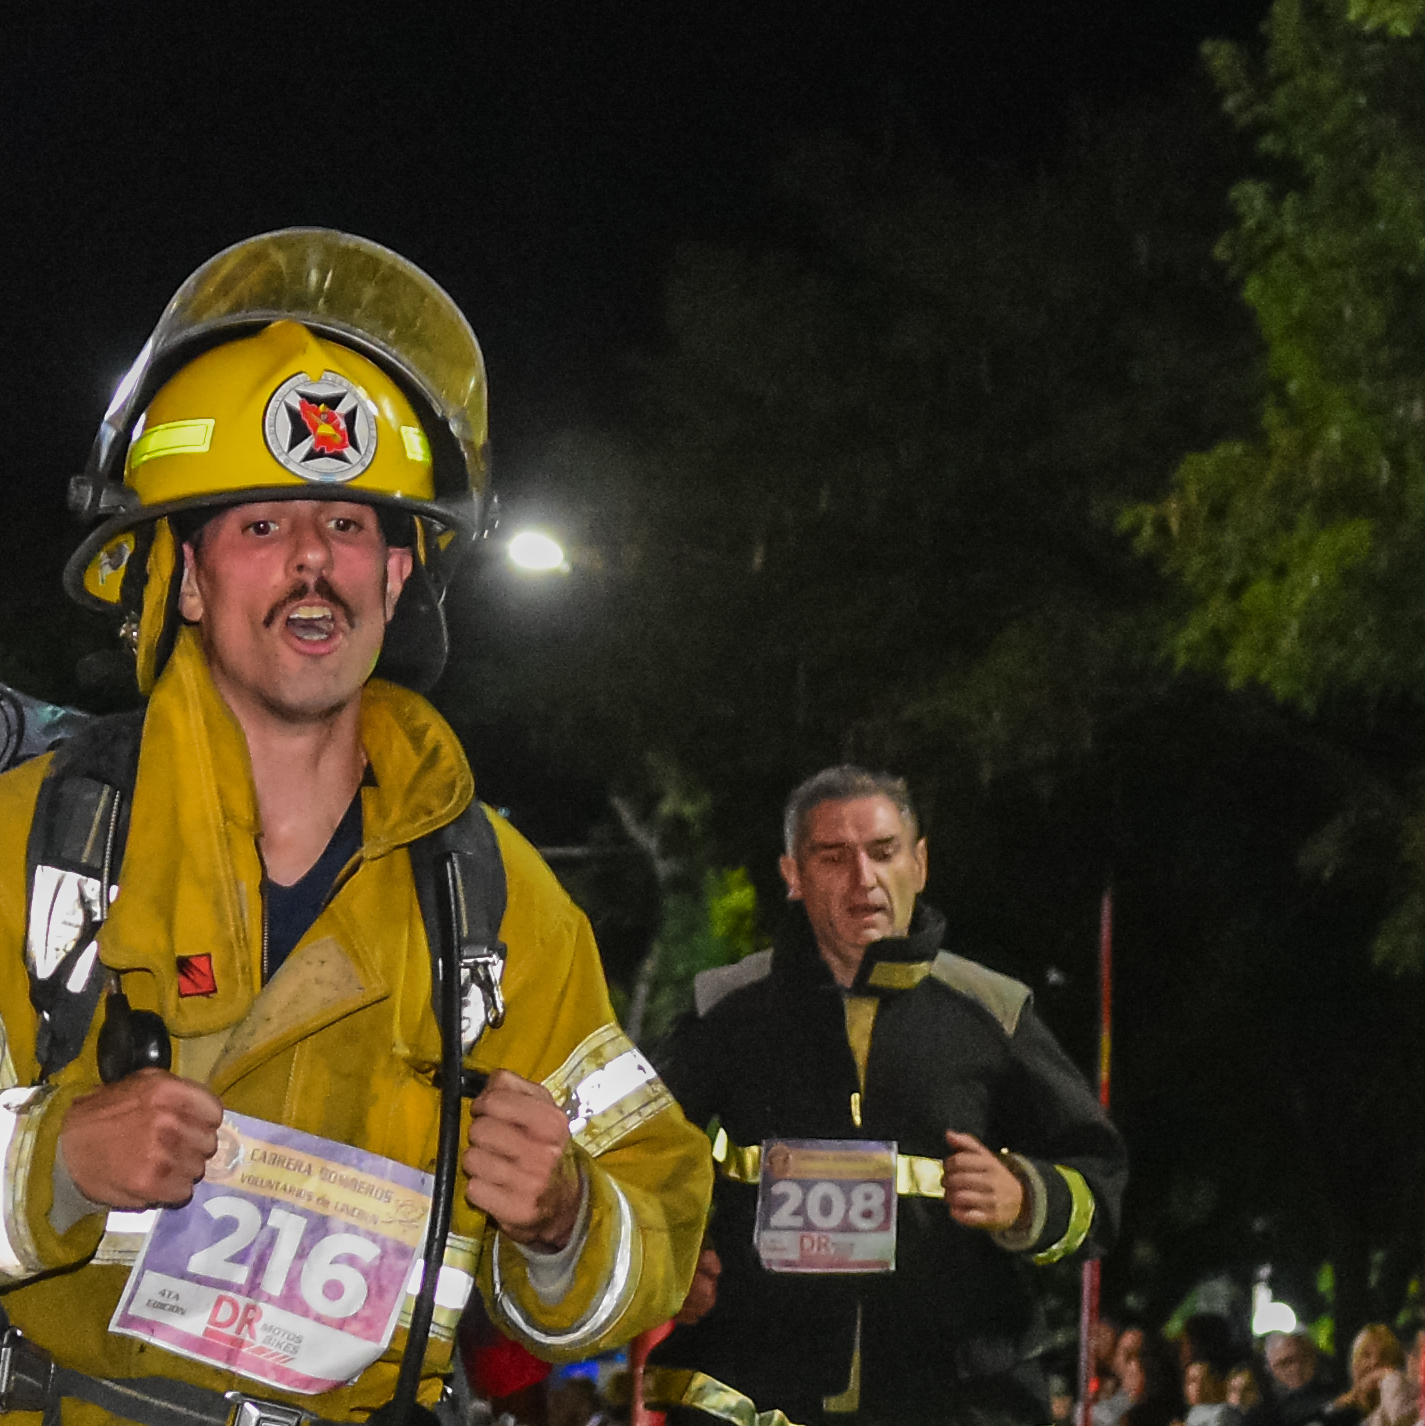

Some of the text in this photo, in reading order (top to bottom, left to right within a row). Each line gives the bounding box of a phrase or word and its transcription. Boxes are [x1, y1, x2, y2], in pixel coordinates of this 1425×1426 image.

[250, 1148, 312, 1176] CARRERA
[770, 1180, 886, 1230] 208
[187, 1195, 382, 1319] 216
[800, 1234, 832, 1253] DR
[206, 1294, 264, 1342] DR
[260, 1322, 304, 1344] MOTOS
[262, 1334, 301, 1355] BIKES
